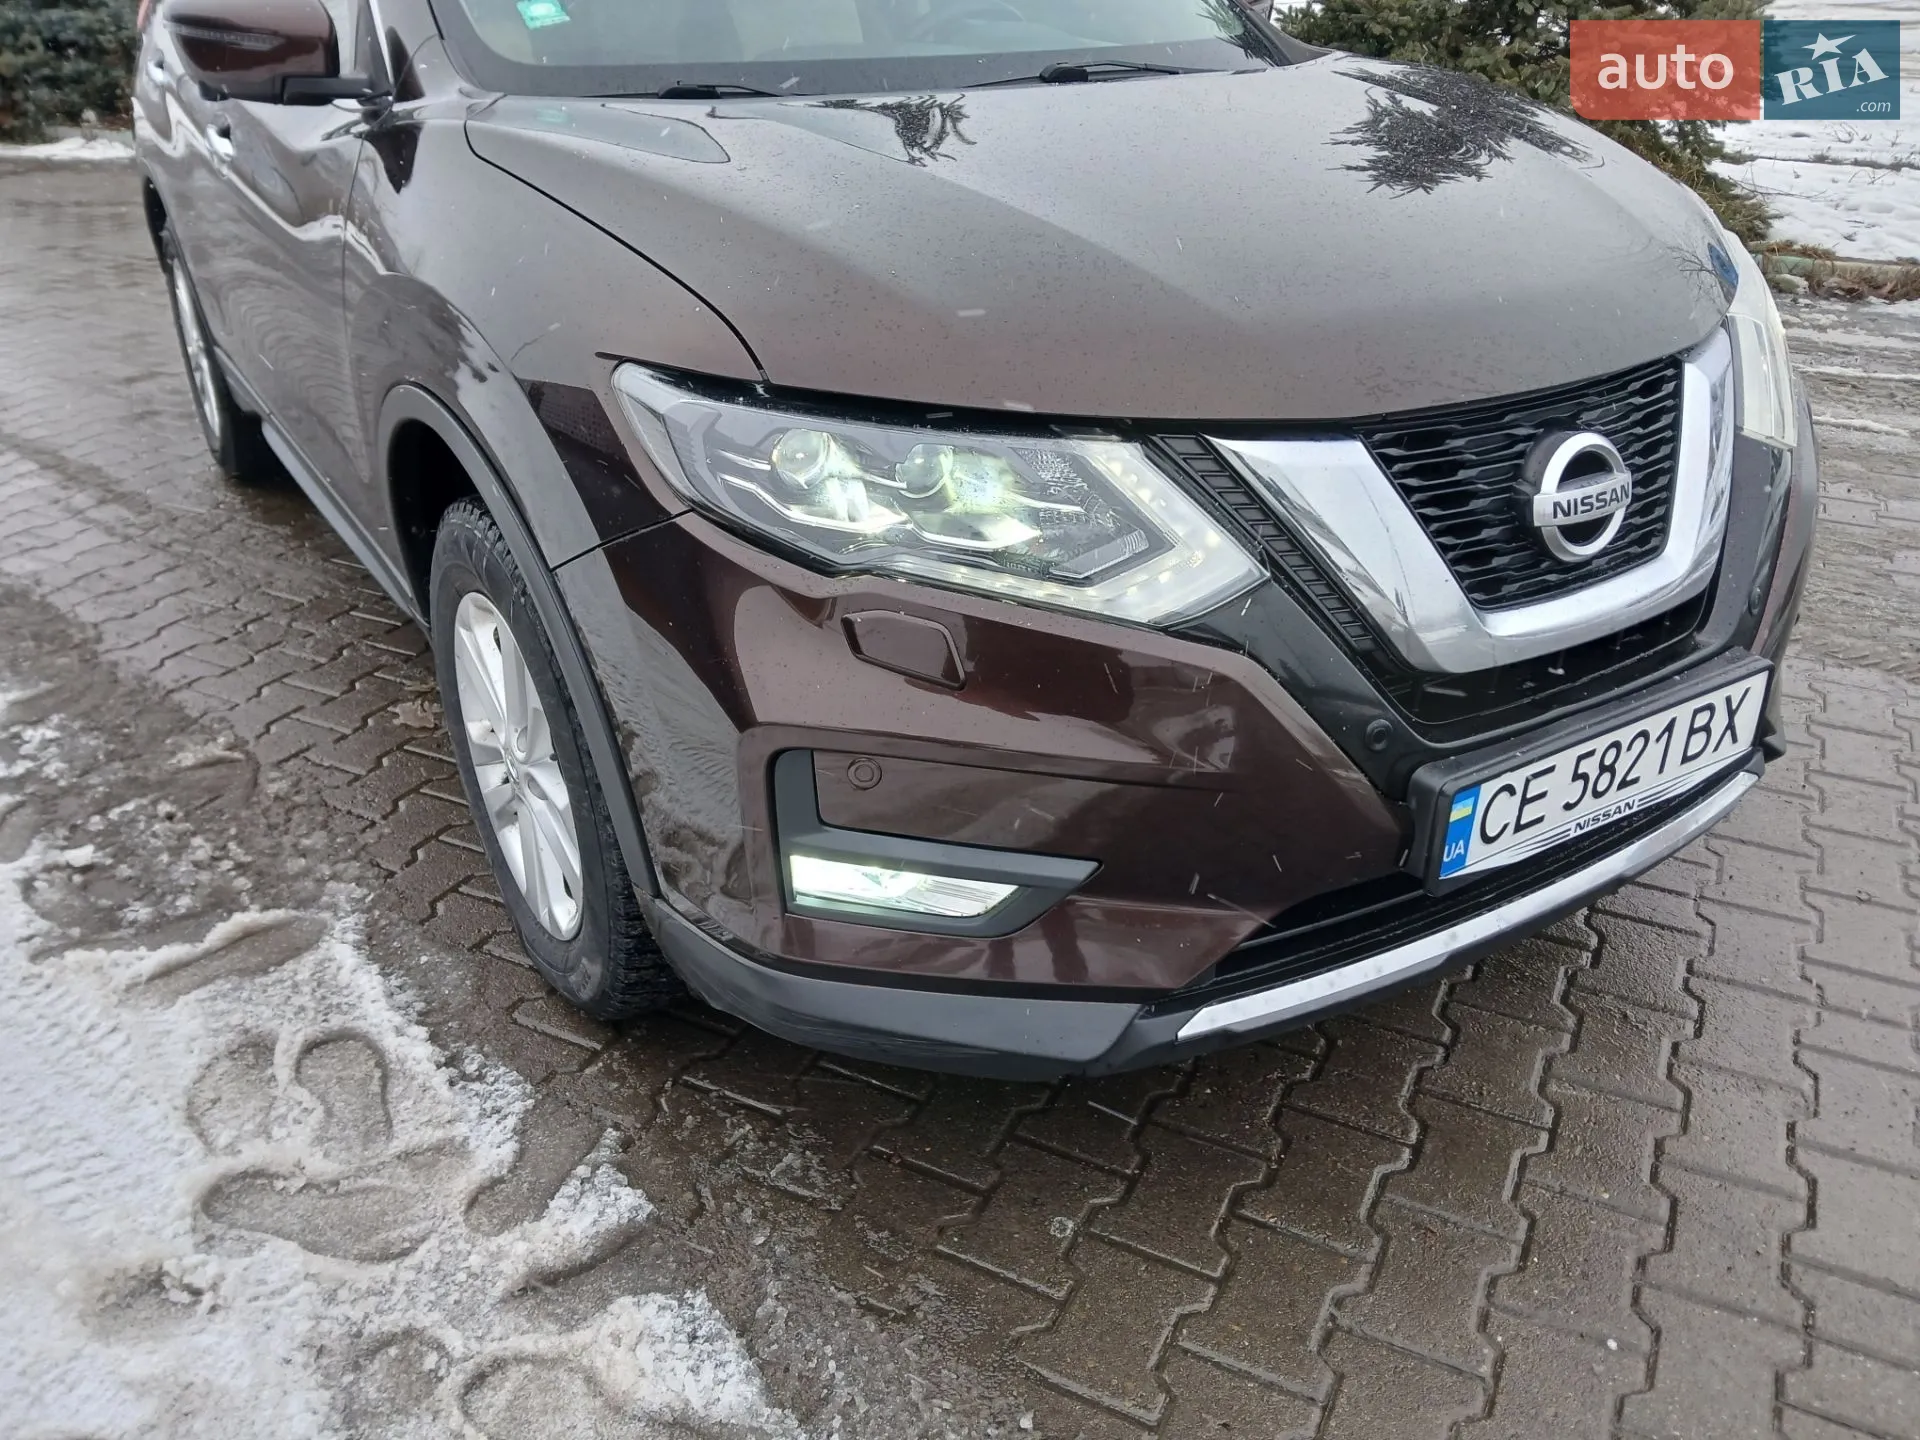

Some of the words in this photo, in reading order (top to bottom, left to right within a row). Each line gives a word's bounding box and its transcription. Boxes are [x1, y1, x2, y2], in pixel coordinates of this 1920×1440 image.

[1552, 482, 1630, 519] NISSAN
[1479, 765, 1555, 844] CE
[1563, 716, 1677, 811] 5821
[1681, 687, 1751, 766] BX
[1573, 798, 1638, 833] NISSAN
[1443, 840, 1465, 863] UA
